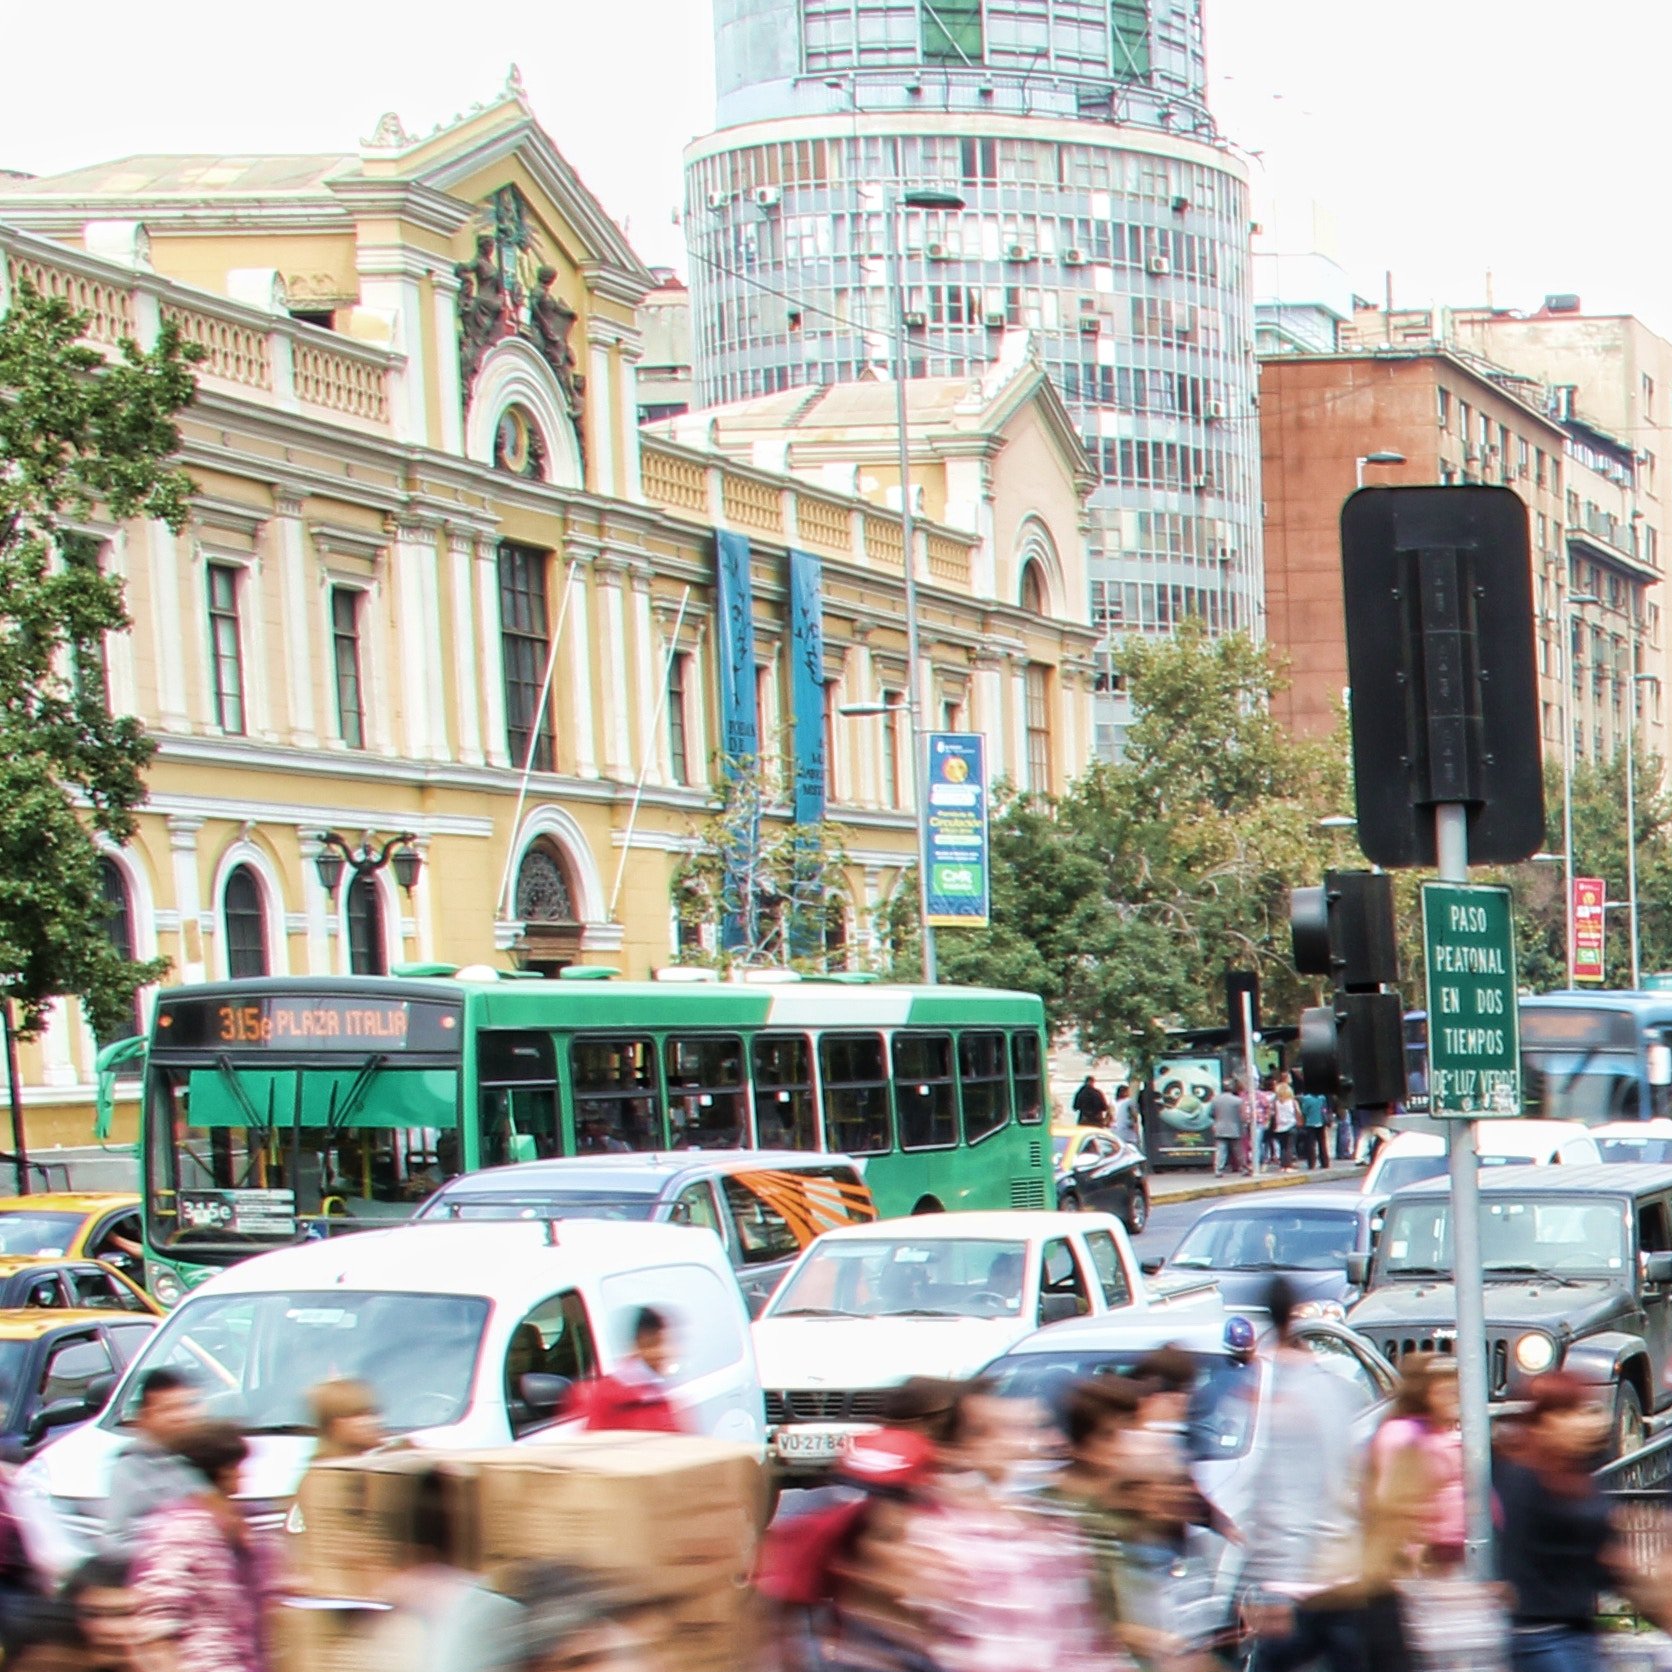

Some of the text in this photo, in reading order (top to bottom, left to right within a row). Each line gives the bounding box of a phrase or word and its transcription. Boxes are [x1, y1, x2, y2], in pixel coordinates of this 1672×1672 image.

[1451, 905, 1487, 932] PASO
[1436, 945, 1505, 974] PEATONAL
[1441, 987, 1503, 1014] EN DOS
[219, 1007, 407, 1041] 315e PLAZA ITALIA
[1444, 1028, 1504, 1055] TIEMPOS
[1433, 1069, 1449, 1095] DE
[1454, 1069, 1477, 1095] LUZ
